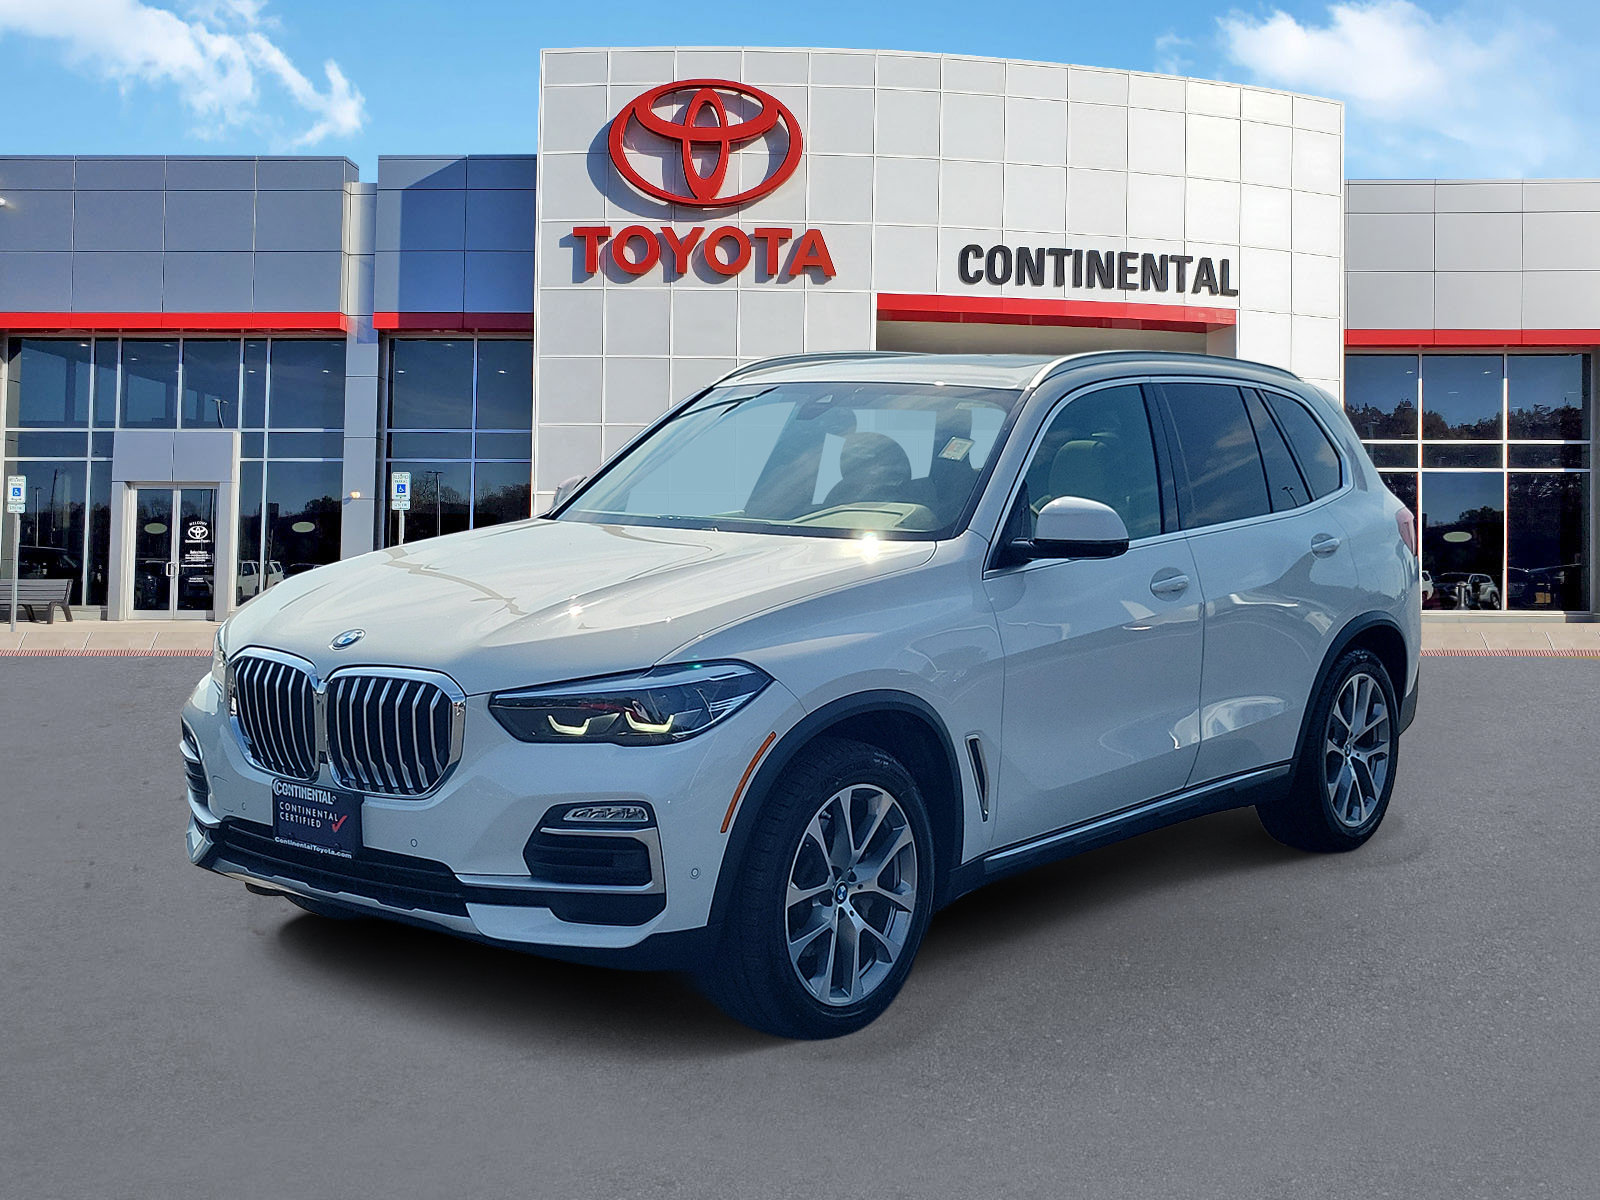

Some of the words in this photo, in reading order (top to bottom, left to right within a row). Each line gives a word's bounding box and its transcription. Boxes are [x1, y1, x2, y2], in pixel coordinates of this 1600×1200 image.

[572, 225, 837, 277] TOYOTA
[958, 243, 1239, 297] CONTINENTAL
[272, 779, 334, 805] CONTINENTAL
[279, 801, 339, 822] CONTINENTAL
[279, 811, 322, 828] CERTIFIED
[274, 836, 353, 859] ContinentalToyota.com
